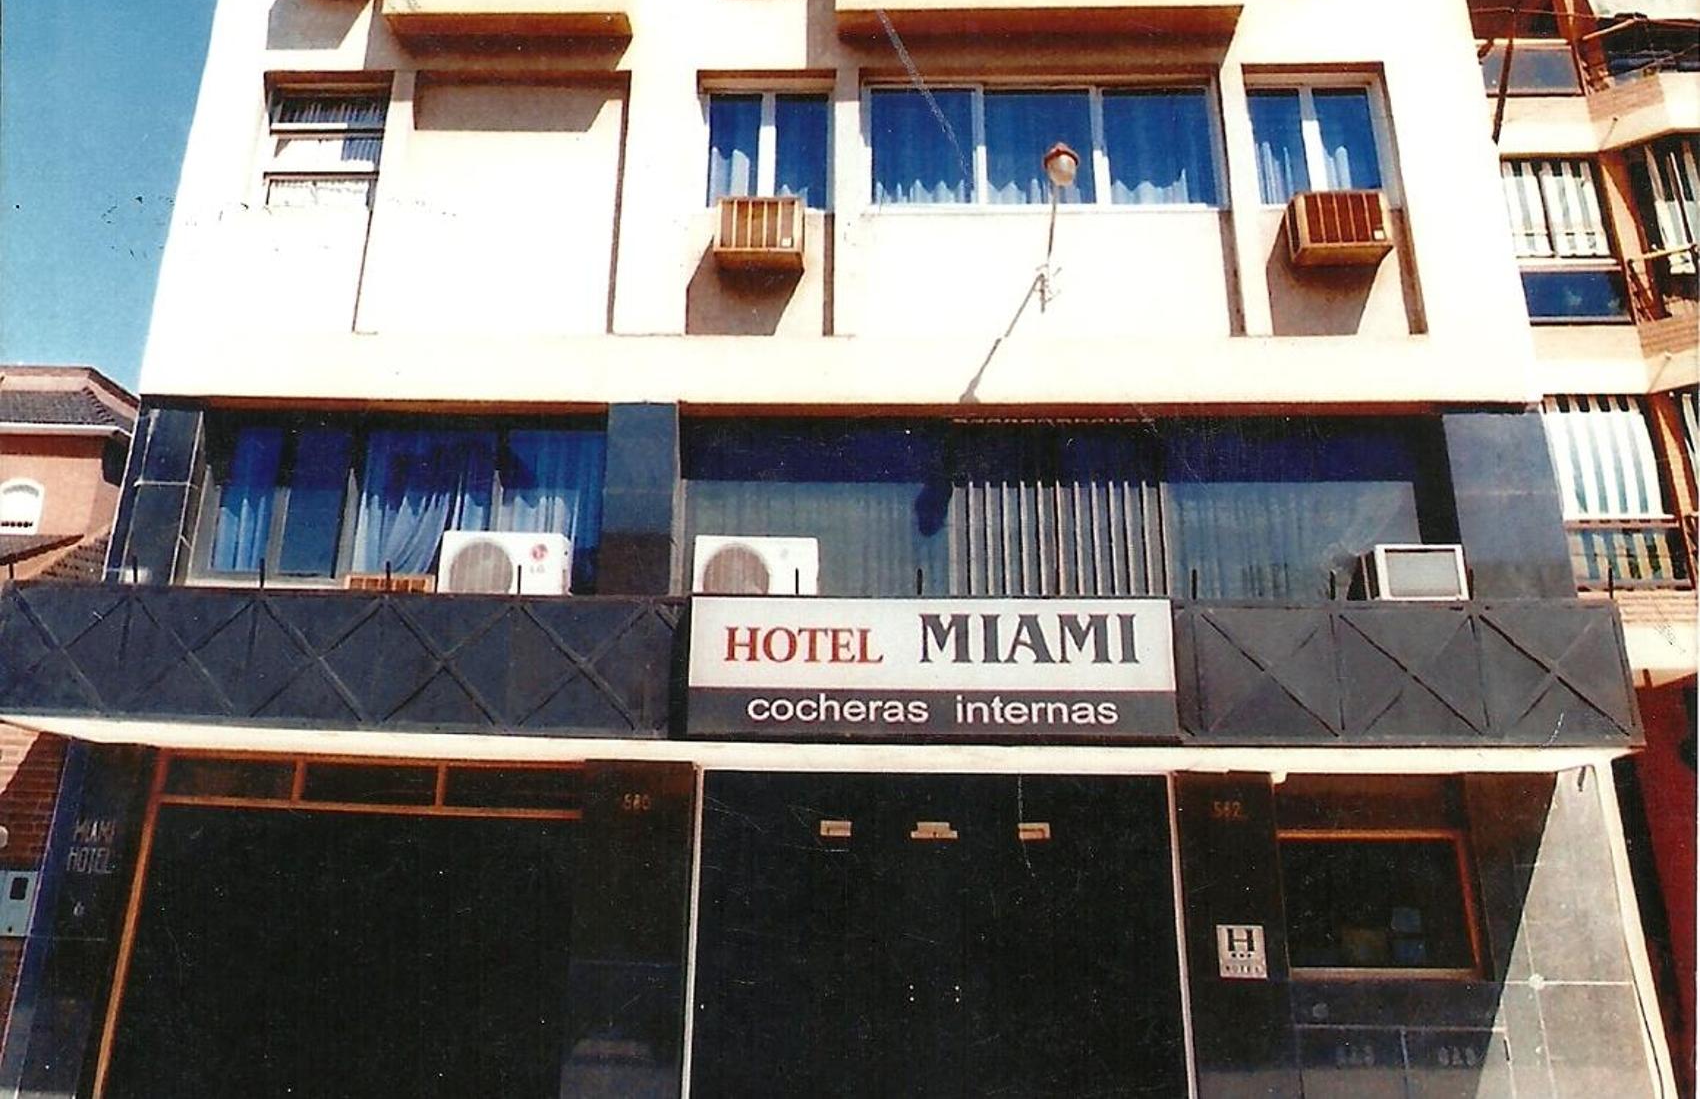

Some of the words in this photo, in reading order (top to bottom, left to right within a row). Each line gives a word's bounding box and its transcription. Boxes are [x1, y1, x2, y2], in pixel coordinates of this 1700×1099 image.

[723, 626, 884, 664] HOTEL
[918, 613, 1140, 664] MIAMI
[747, 692, 929, 723] cocheras
[956, 694, 1119, 724] internas
[1227, 928, 1255, 952] H
